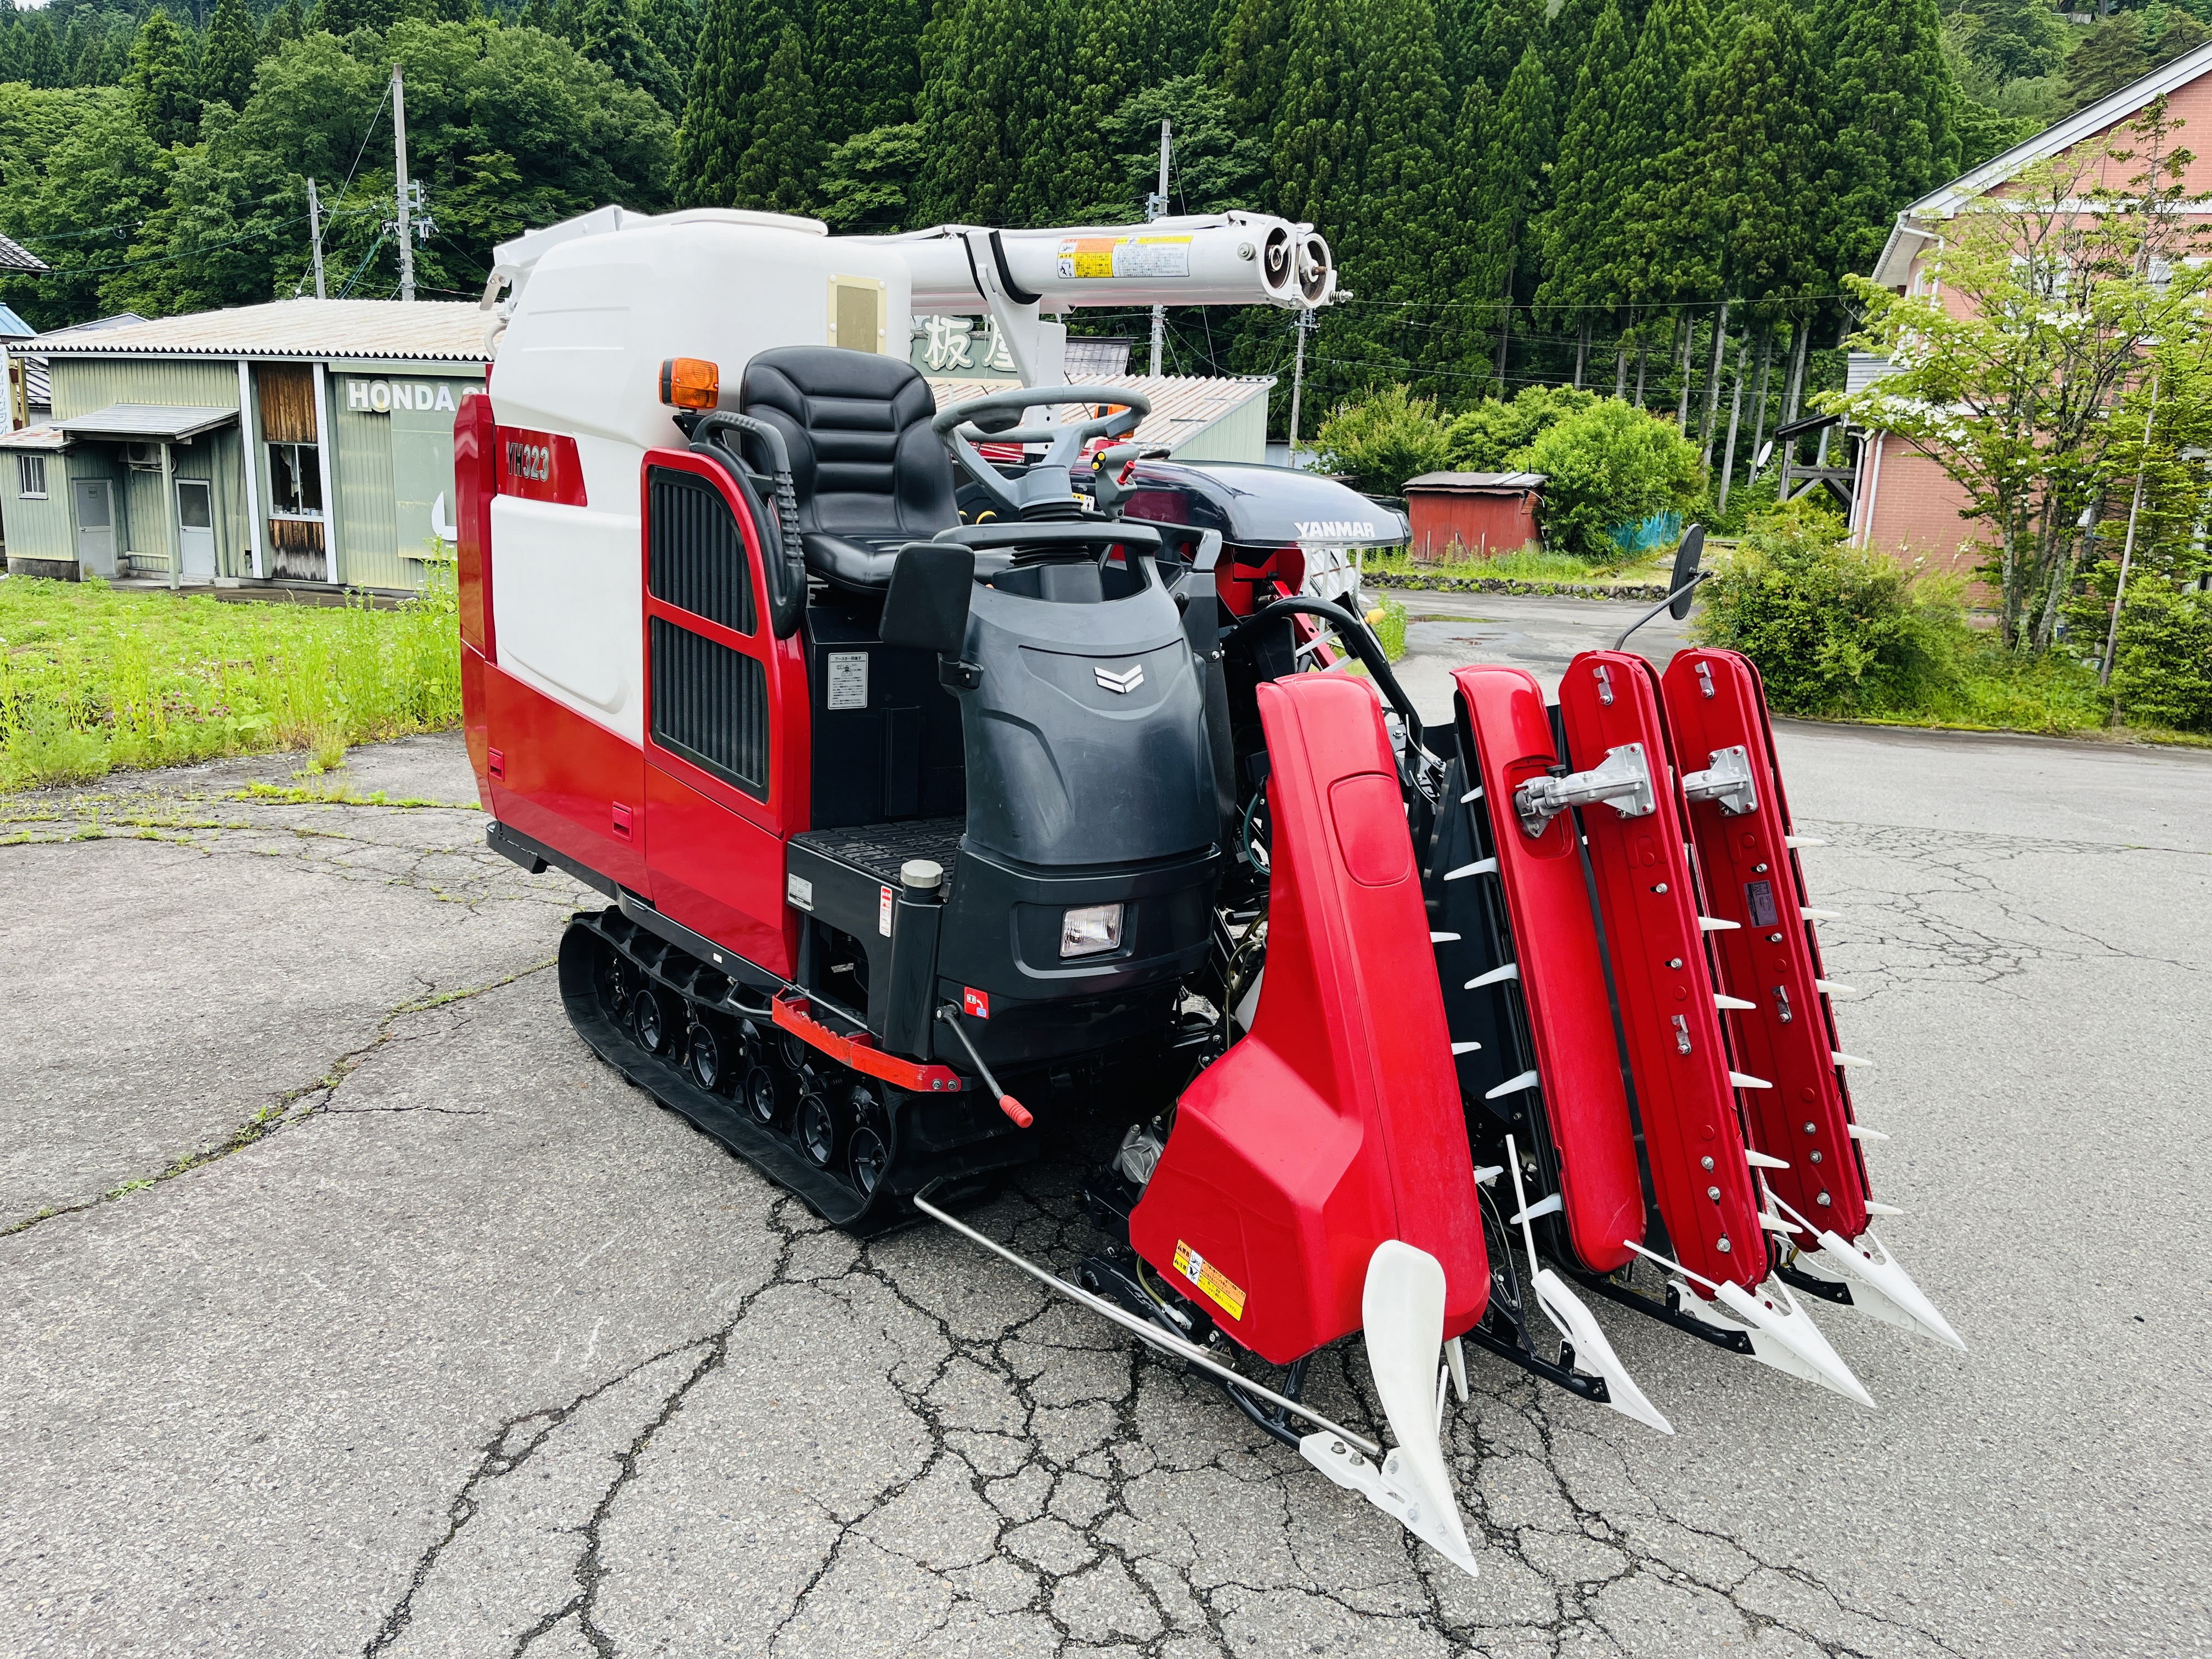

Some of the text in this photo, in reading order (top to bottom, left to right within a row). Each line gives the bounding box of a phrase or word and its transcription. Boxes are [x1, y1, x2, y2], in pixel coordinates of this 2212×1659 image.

[348, 382, 455, 411] HONDA
[506, 441, 550, 482] YH323
[1294, 521, 1375, 538] YANMAR
